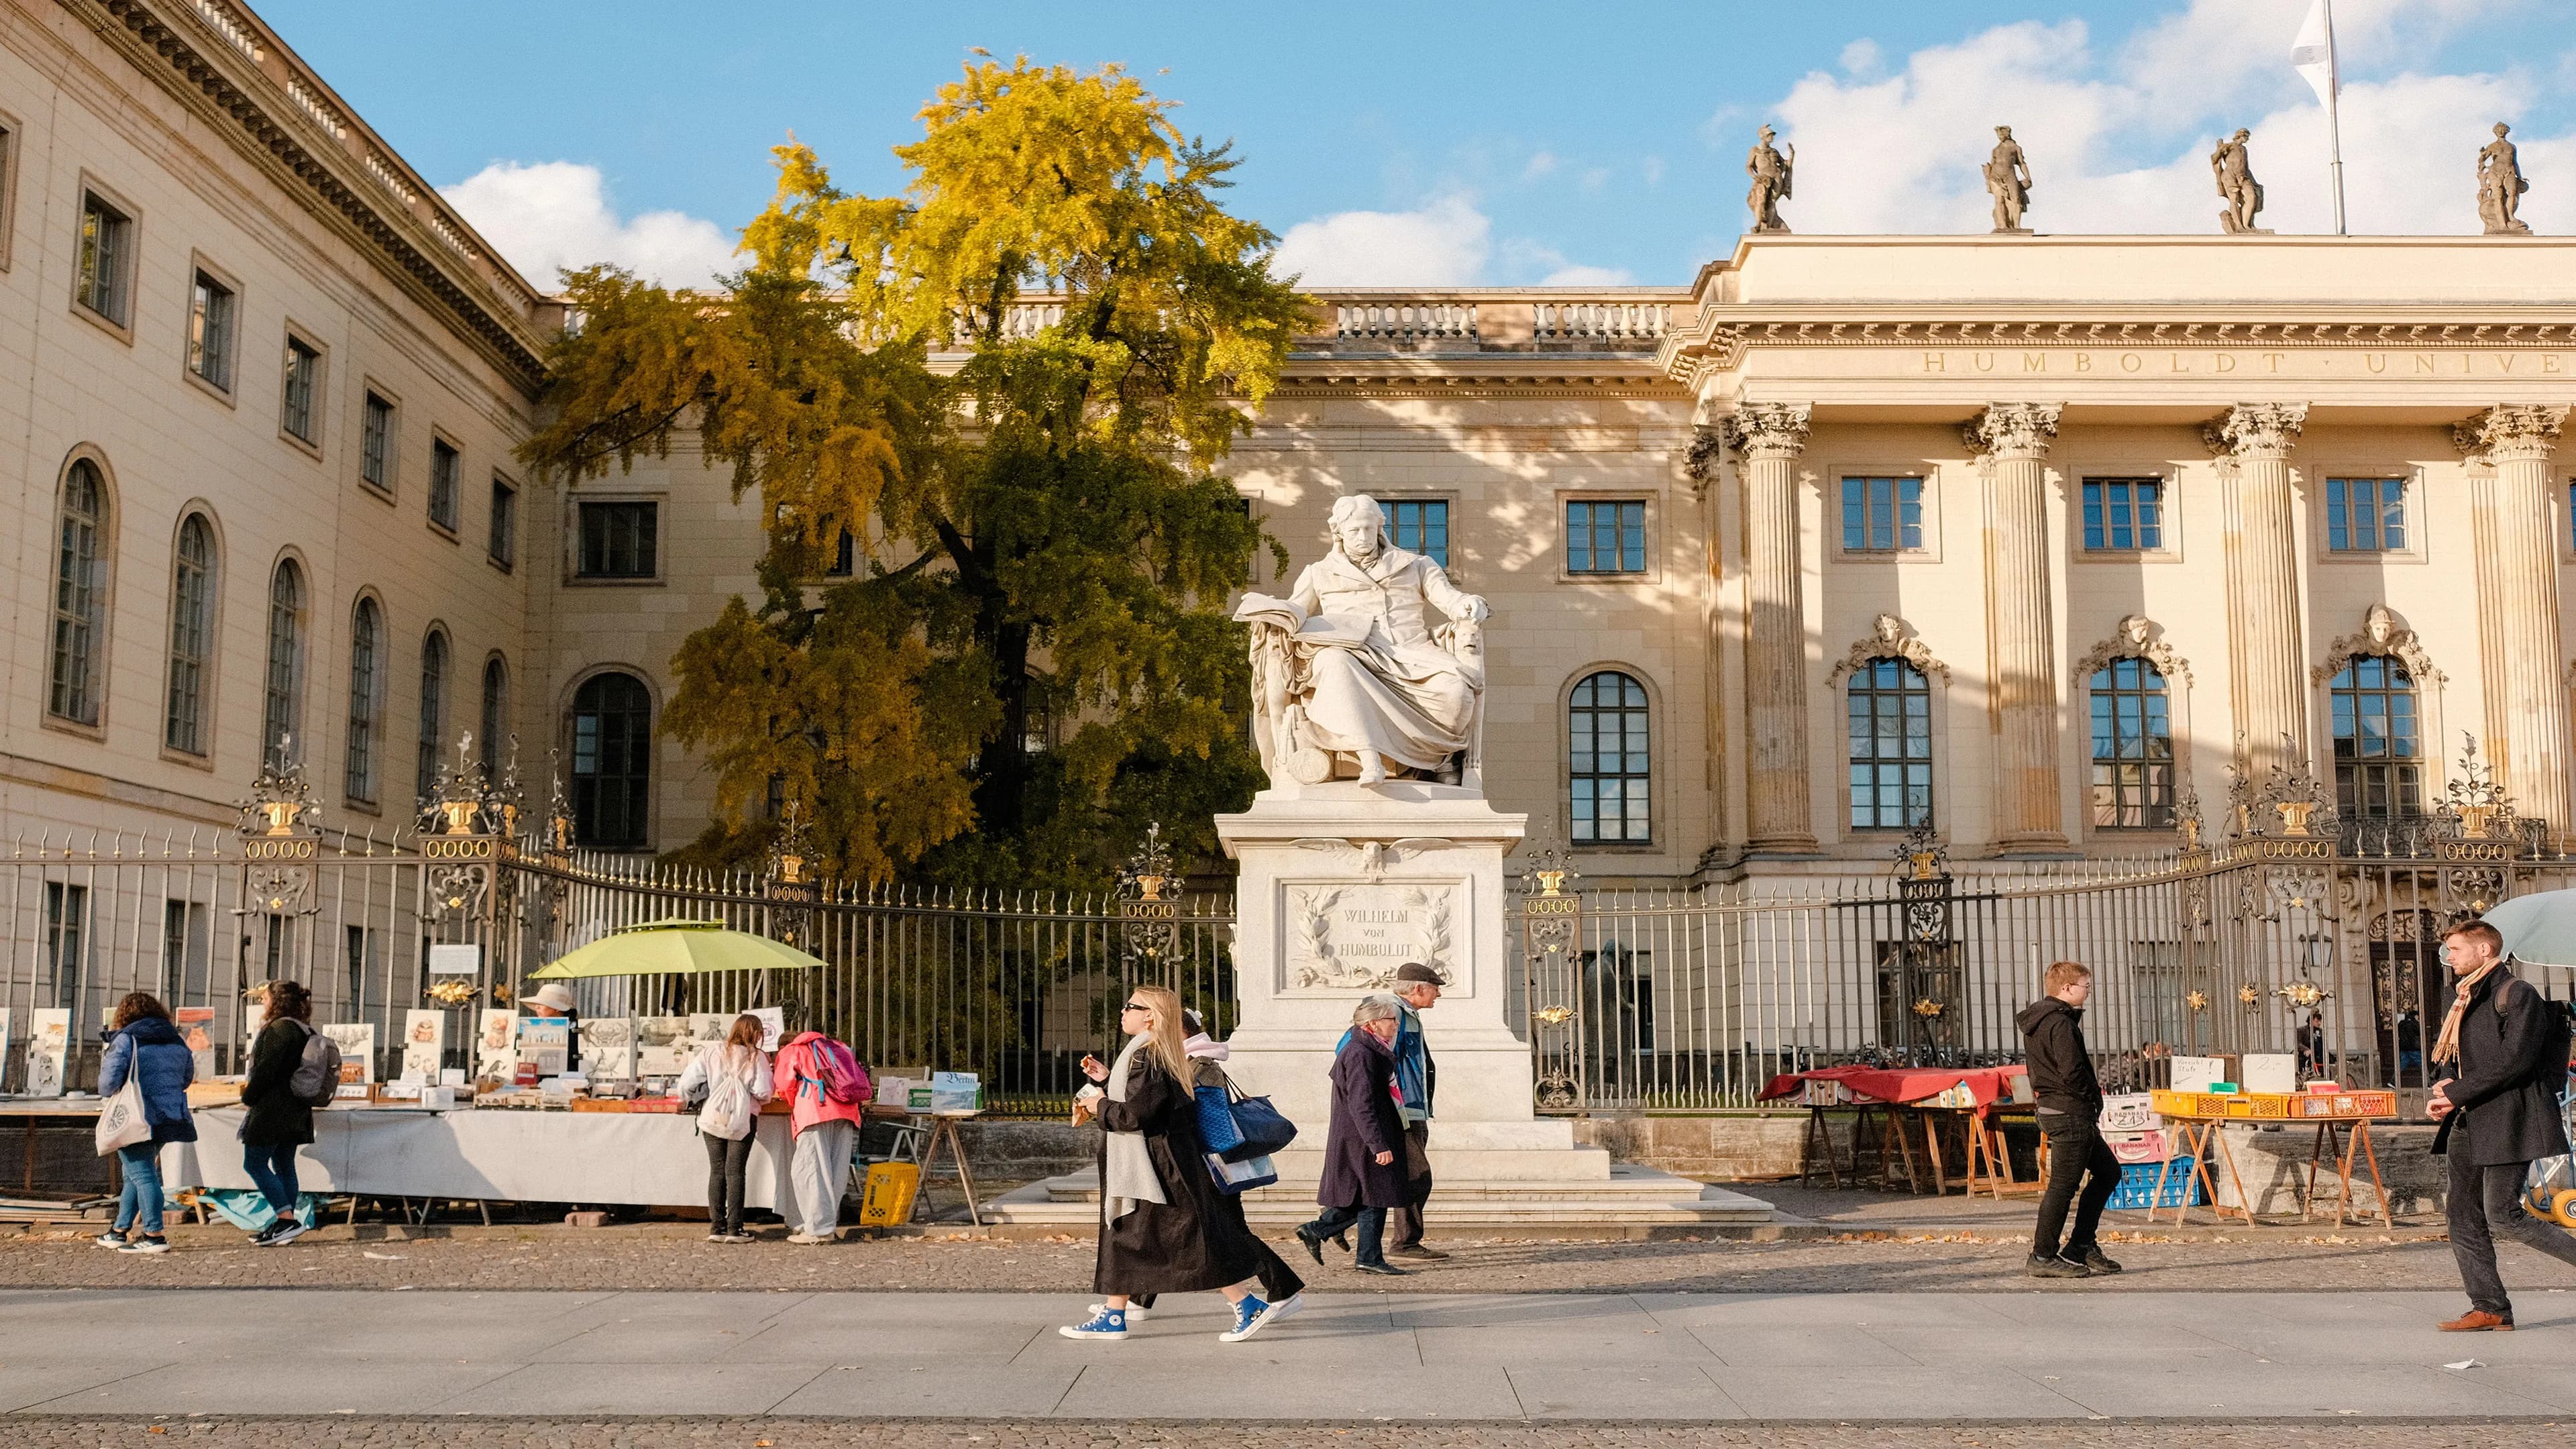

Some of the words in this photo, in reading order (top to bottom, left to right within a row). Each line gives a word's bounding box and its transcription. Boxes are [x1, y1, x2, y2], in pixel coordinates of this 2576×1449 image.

[1923, 352, 2285, 373] HUMBOLDT
[1344, 909, 1408, 923] WILHELM
[1340, 943, 1412, 957] HUMBOLDT
[947, 1073, 975, 1084] Berlin
